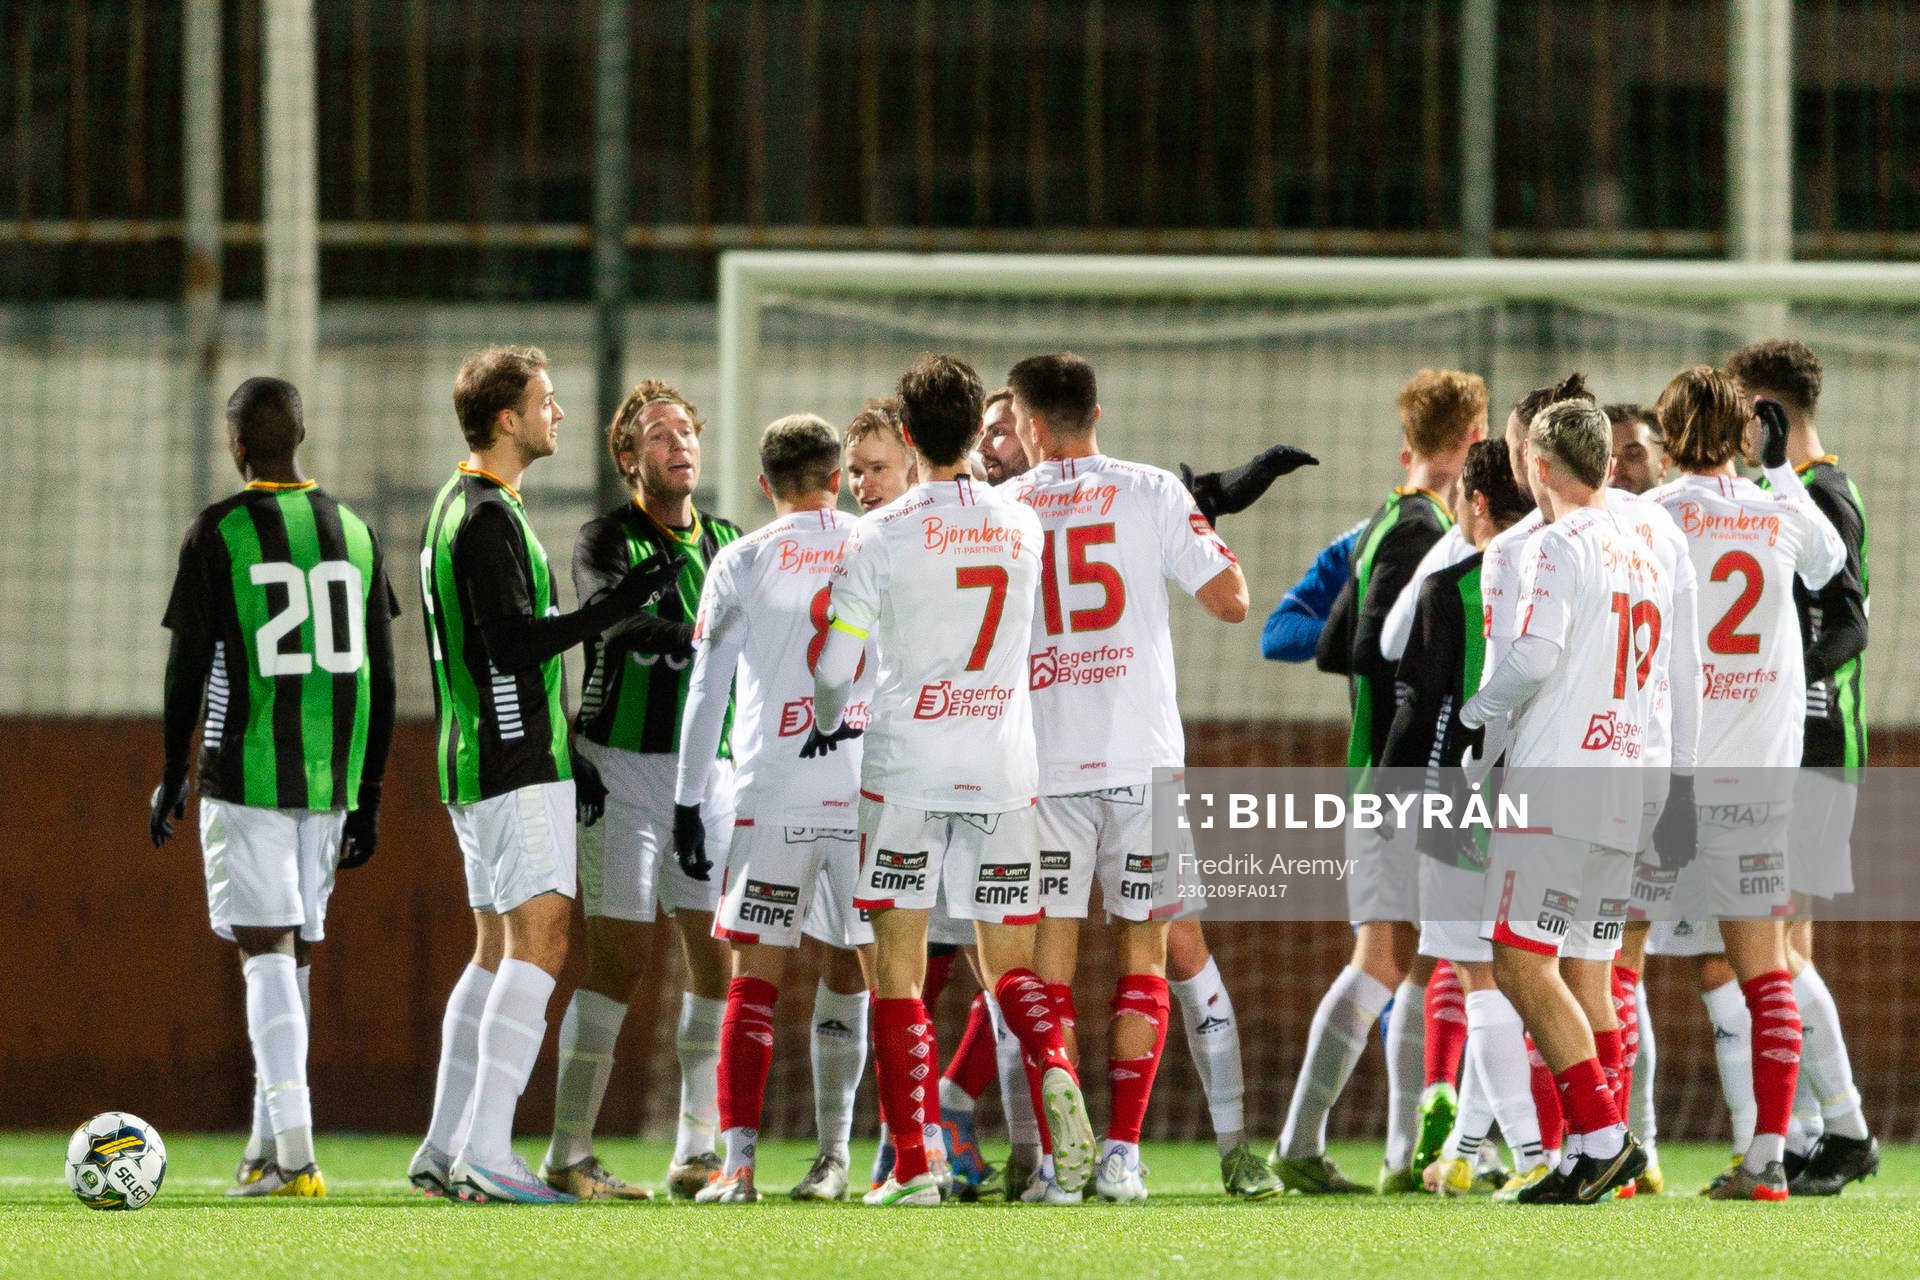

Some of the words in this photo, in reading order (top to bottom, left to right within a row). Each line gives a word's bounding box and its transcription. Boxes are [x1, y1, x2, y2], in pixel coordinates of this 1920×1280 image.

[1679, 502, 1782, 547] Björnberg
[922, 516, 1023, 560] Björnberg
[954, 545, 1004, 555] IT-PARTNER
[778, 539, 845, 574] Björn
[1041, 522, 1126, 636] 15
[1707, 550, 1765, 655] 2
[250, 560, 364, 677] 20
[956, 565, 1009, 672] 7
[1611, 591, 1662, 700] 19
[1057, 663, 1127, 685] Byggen
[1710, 685, 1759, 703] Energ
[948, 702, 1003, 720] Energi
[1611, 735, 1641, 759] Bygg
[1080, 760, 1107, 770] umbro
[954, 783, 982, 792] umbro
[1041, 856, 1067, 864] URITY
[871, 871, 926, 890] EMPE
[975, 886, 1029, 904] EMPE
[740, 902, 795, 928] EMPE
